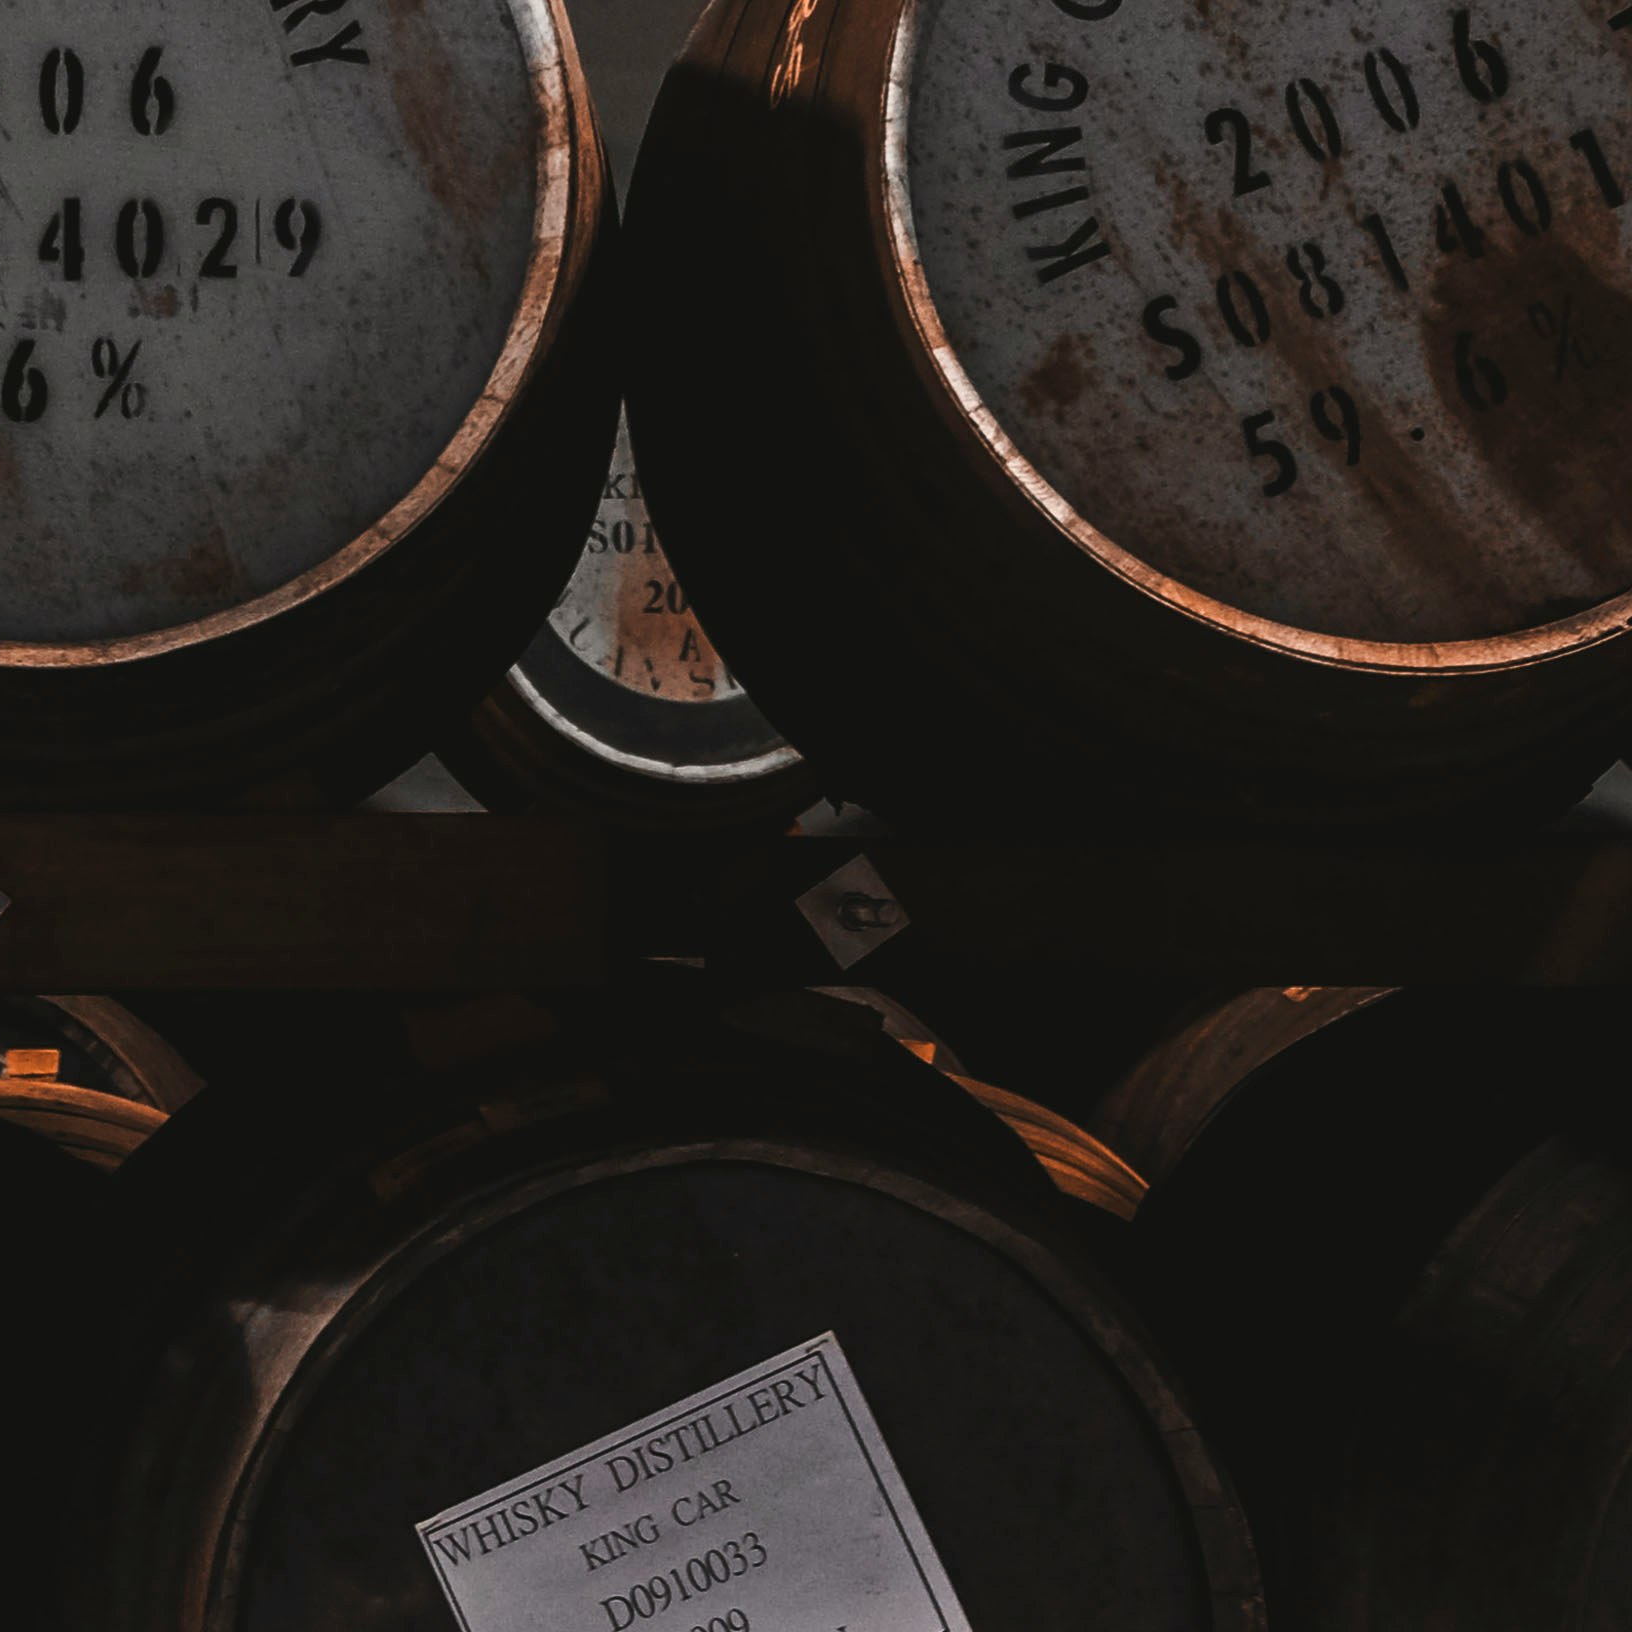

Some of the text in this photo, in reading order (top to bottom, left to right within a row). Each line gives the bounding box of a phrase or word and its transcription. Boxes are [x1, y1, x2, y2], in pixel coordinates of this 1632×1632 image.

[1003, 64, 1111, 285] KING
[1205, 10, 1508, 197] 2006
[1143, 129, 1623, 380] S081401
[433, 1363, 828, 1567] WHISKY DISTILLERY
[578, 1479, 741, 1573] KING CAR
